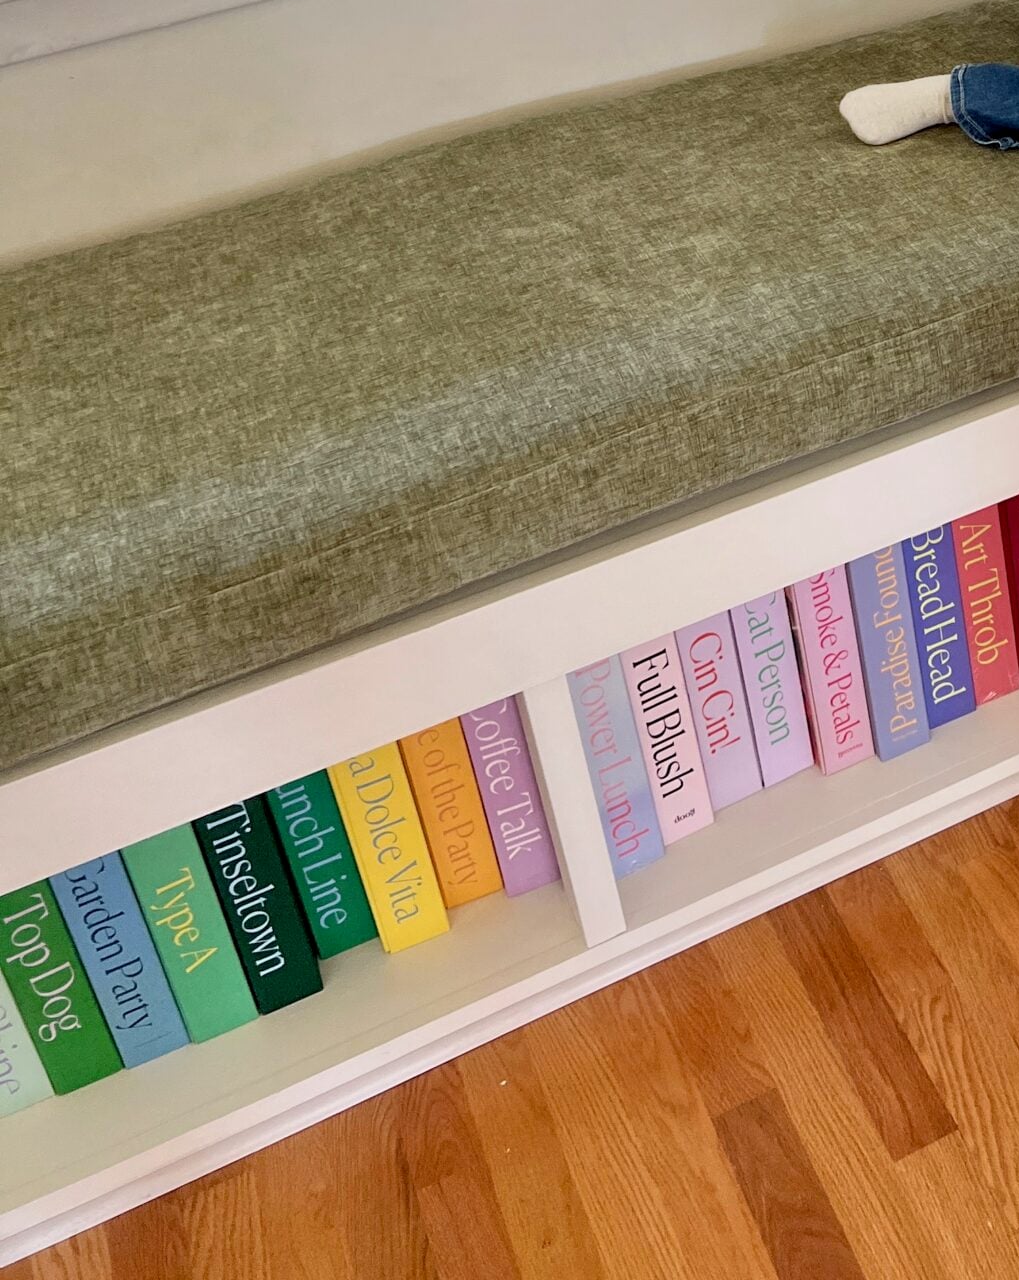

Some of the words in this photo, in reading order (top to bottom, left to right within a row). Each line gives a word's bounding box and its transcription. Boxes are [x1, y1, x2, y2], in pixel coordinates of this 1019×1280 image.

[911, 524, 956, 621] Bread
[959, 523, 993, 570] Art
[809, 568, 844, 650] Smoke
[968, 566, 1009, 666] Throb
[632, 648, 679, 714] Full
[689, 631, 724, 692] Cin
[754, 639, 791, 746] Person
[822, 649, 849, 676] &
[881, 627, 918, 734] Paradise
[924, 616, 967, 706] Head
[701, 689, 742, 755] Cin!
[827, 671, 861, 746] Petals
[423, 749, 461, 777] of
[575, 657, 619, 758] Power
[598, 756, 651, 860] Lunch
[646, 707, 695, 799] Blush
[431, 778, 465, 823] the
[496, 790, 543, 861] Talk
[356, 773, 407, 865] Dolce
[386, 859, 423, 925] Vita
[442, 820, 478, 887] Party
[150, 866, 200, 947] Type
[179, 947, 219, 974] A
[206, 801, 286, 977] Tinseltown
[302, 852, 348, 929] Line
[3, 893, 50, 968] Top
[29, 961, 83, 1043] Dog
[105, 957, 153, 1031] Party
